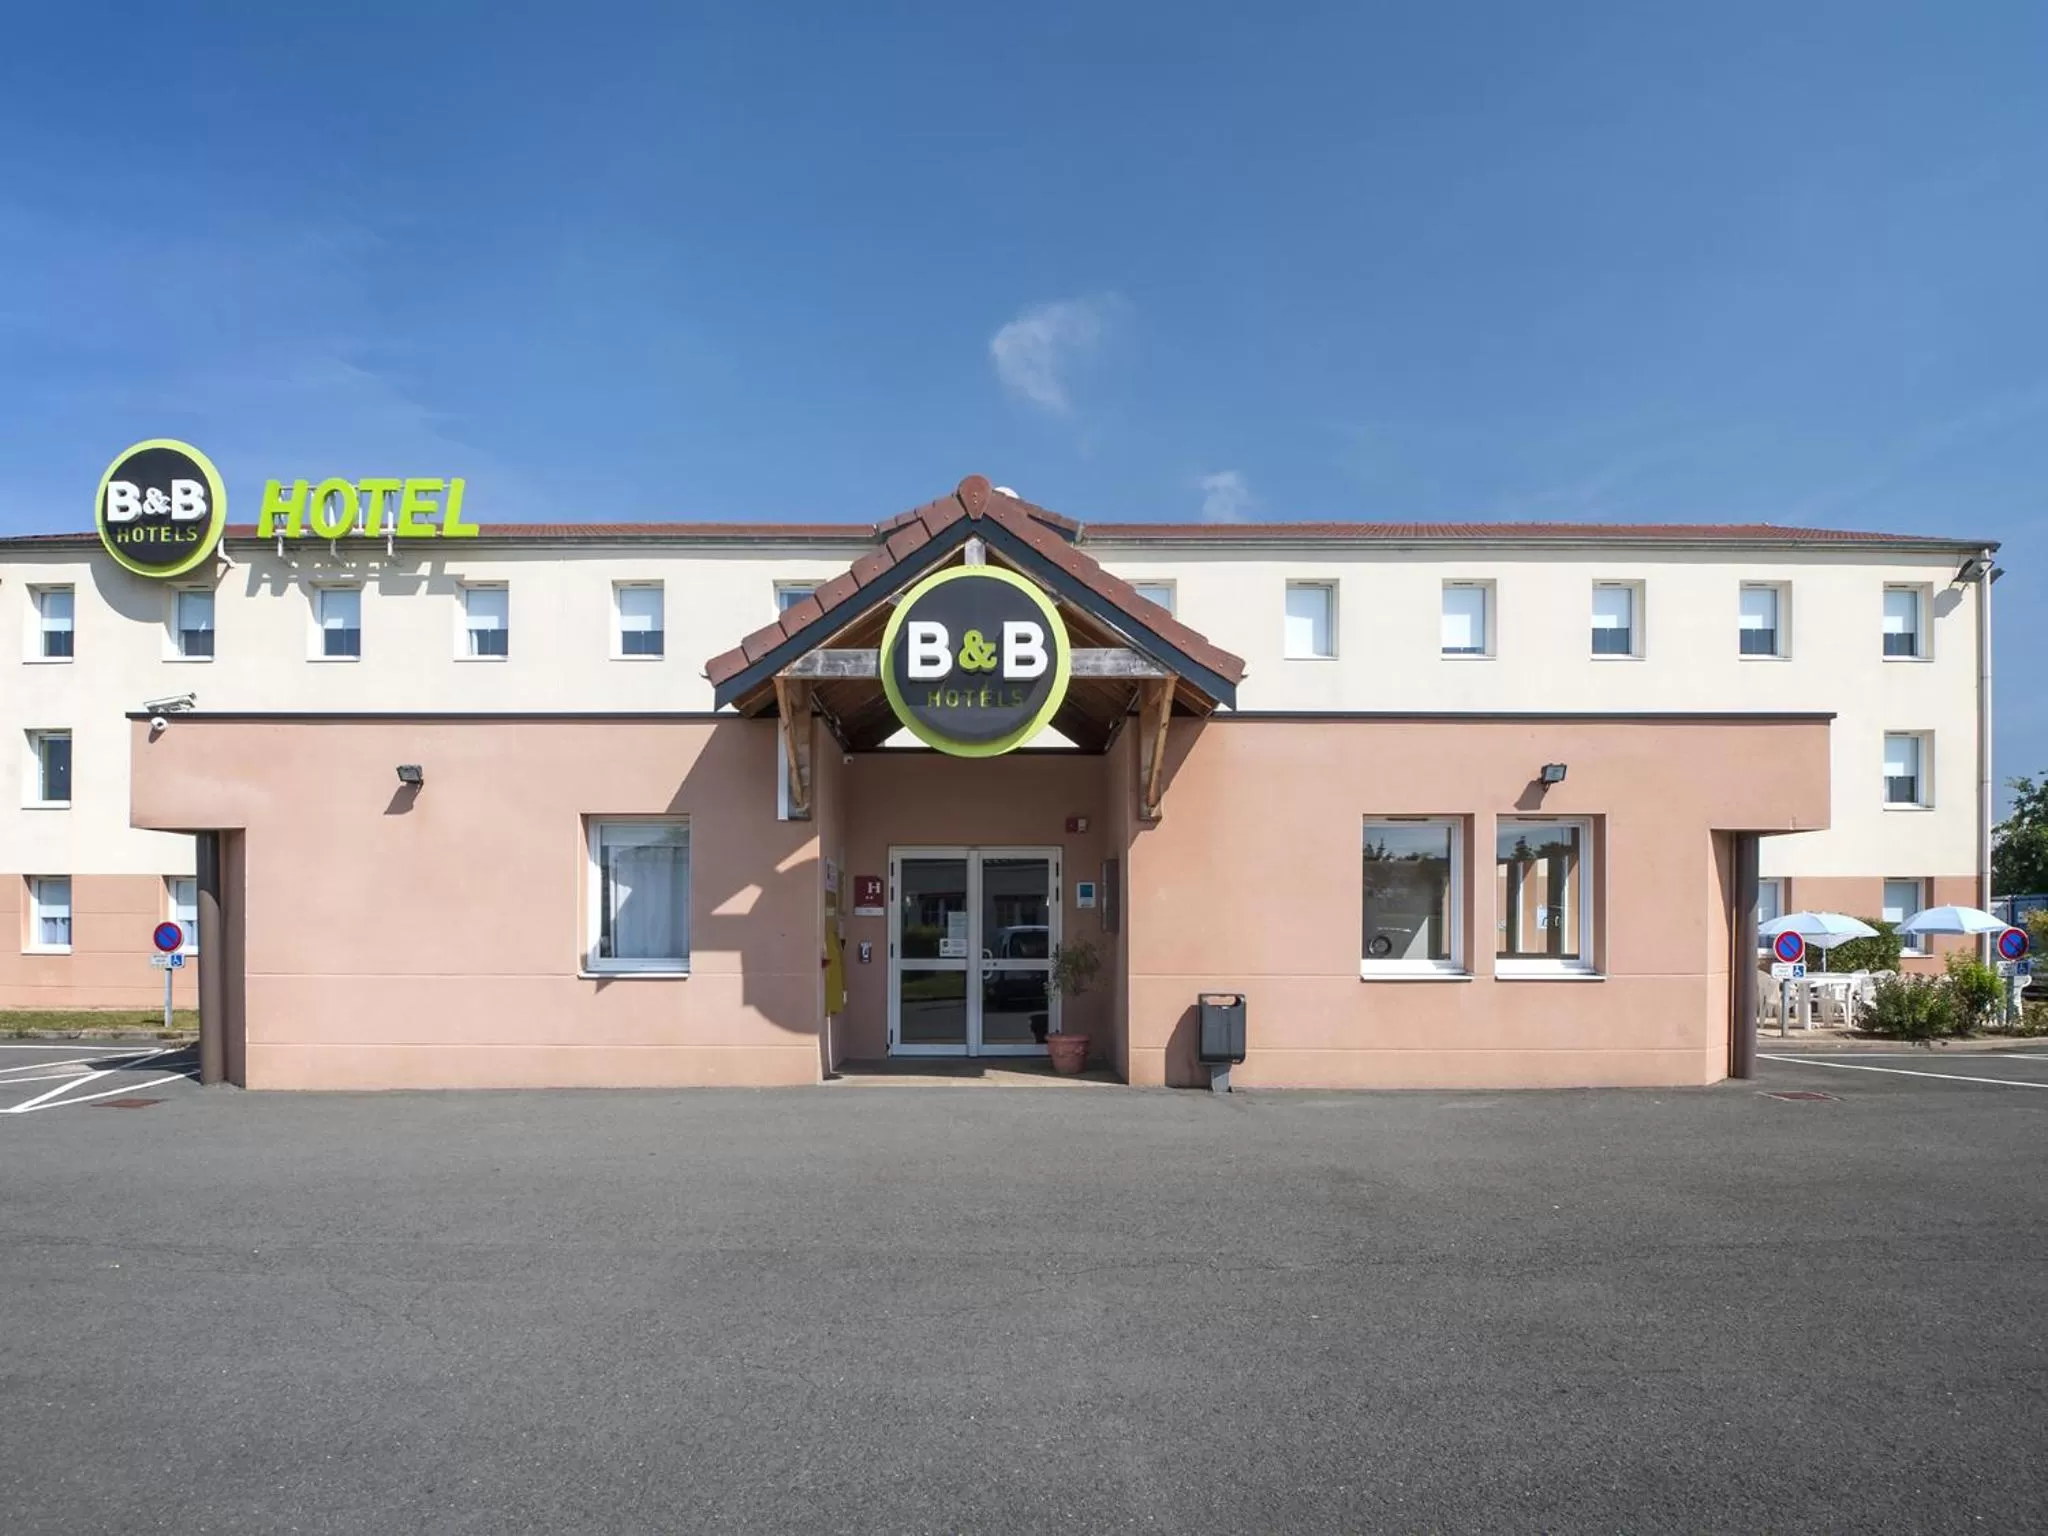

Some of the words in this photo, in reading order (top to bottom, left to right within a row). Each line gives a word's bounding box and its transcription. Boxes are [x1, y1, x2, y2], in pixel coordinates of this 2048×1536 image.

[107, 479, 207, 522] B&B
[257, 477, 480, 539] HOTEL
[116, 525, 199, 543] HOTELS
[907, 620, 1049, 682] B&B
[926, 688, 1025, 709] HOTELS
